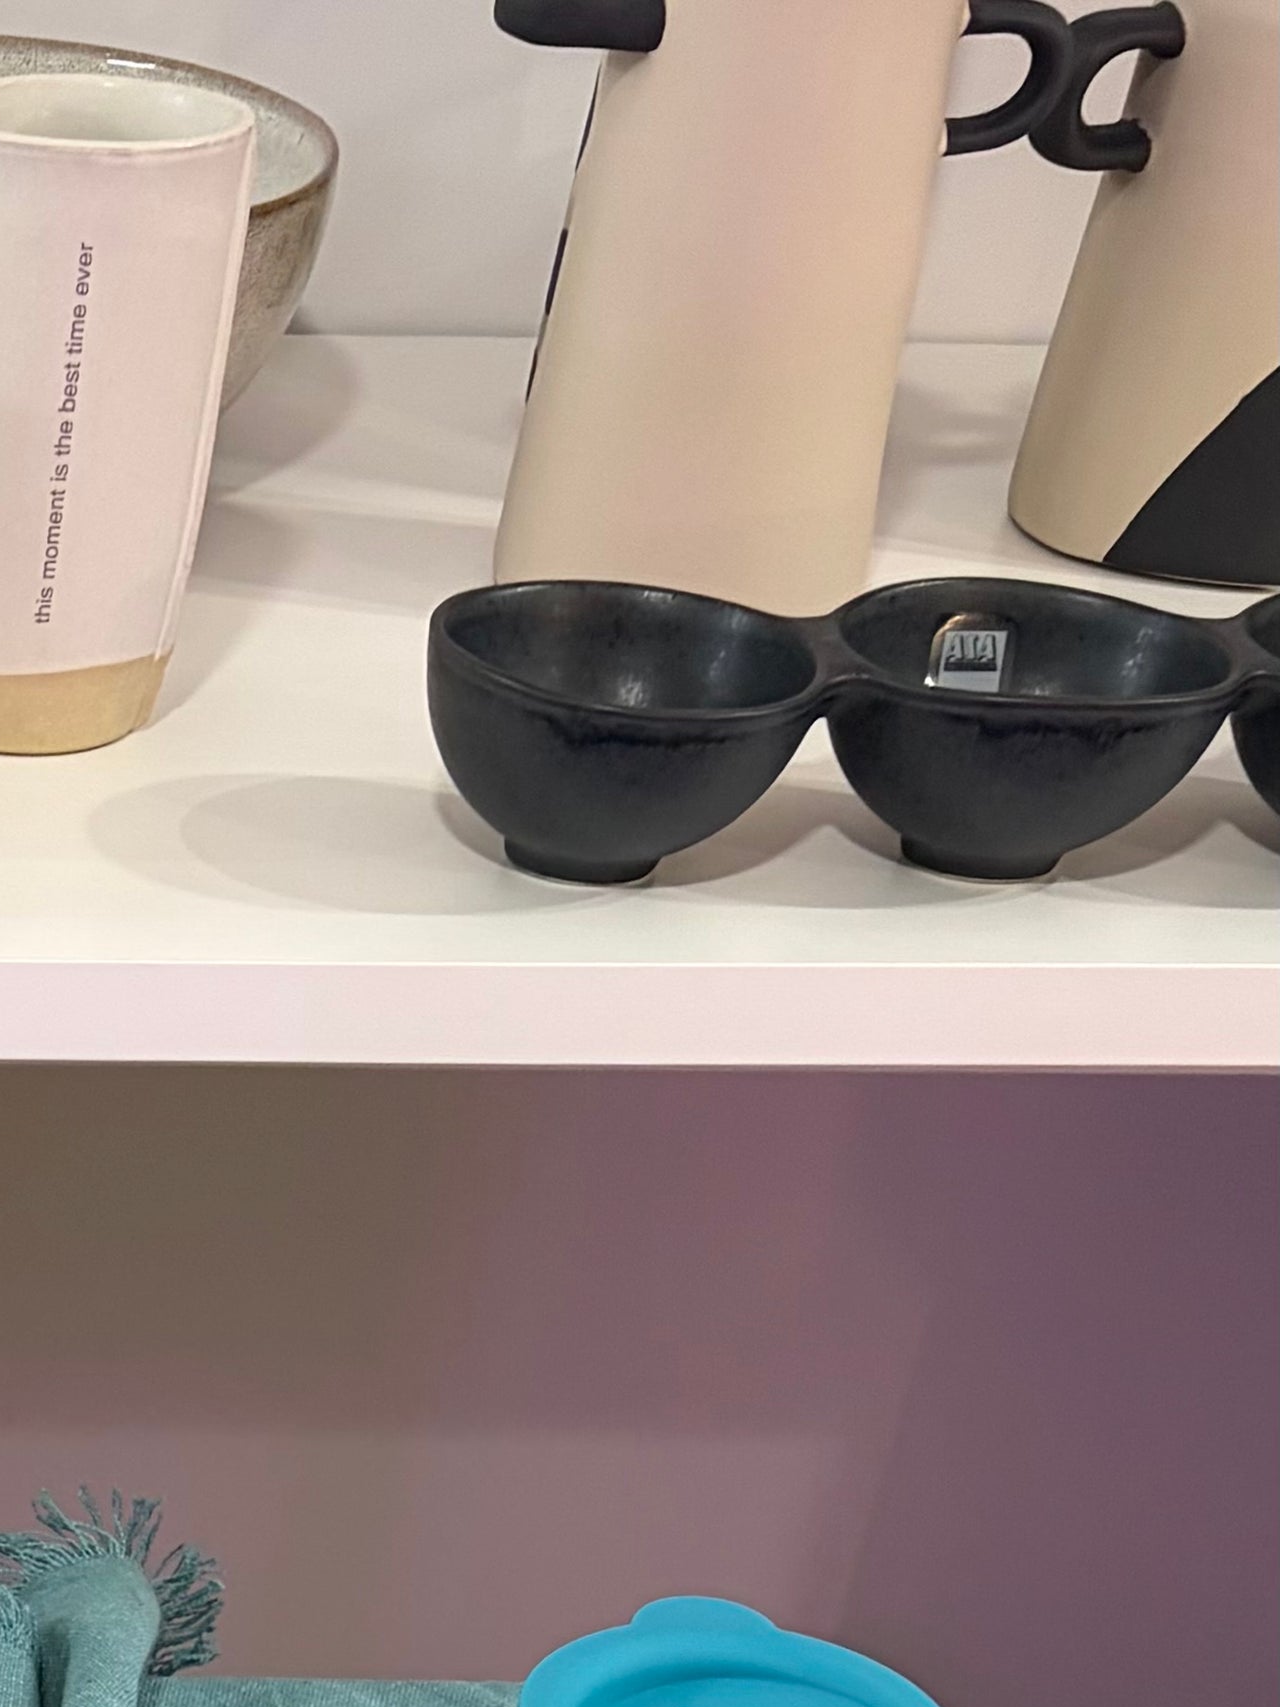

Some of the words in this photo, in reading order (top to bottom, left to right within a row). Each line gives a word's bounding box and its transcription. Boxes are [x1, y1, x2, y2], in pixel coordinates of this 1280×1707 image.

[75, 242, 94, 297] ever
[65, 304, 87, 355] time
[58, 361, 81, 413] best
[53, 421, 74, 457] the
[50, 464, 69, 482] is
[42, 489, 67, 580] moment
[34, 586, 54, 624] this
